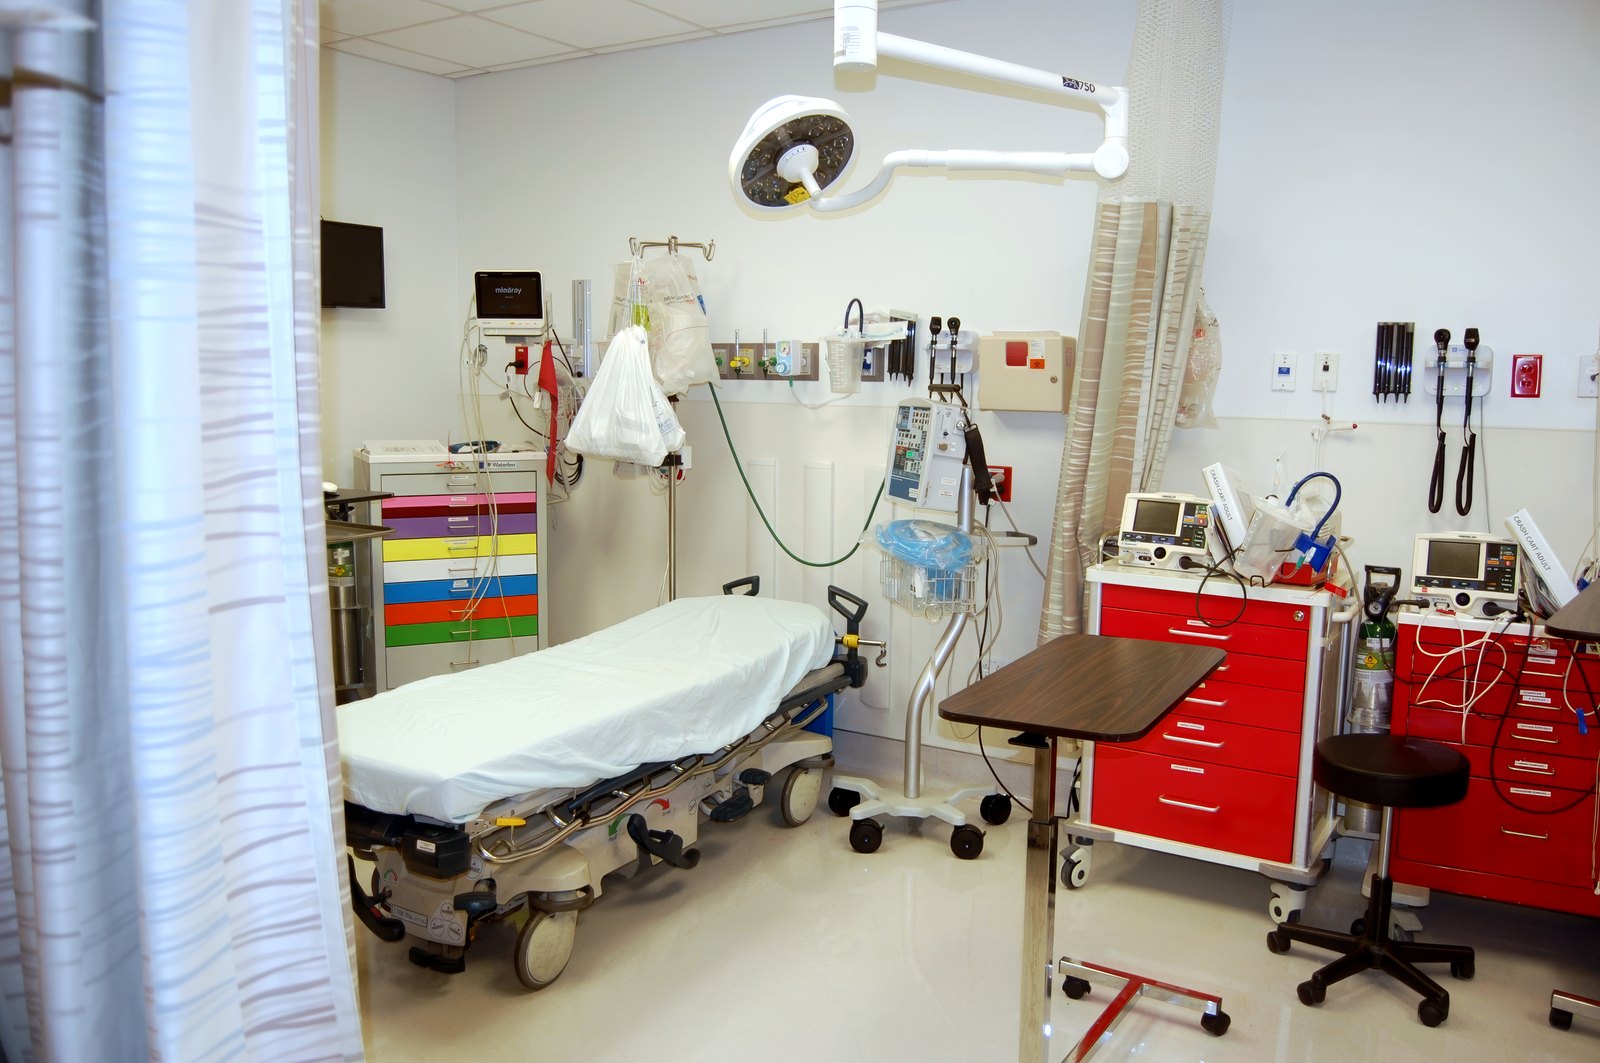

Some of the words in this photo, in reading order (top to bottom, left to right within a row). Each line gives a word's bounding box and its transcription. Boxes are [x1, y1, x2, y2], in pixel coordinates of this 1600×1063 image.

[1079, 81, 1095, 93] 750
[495, 287, 522, 295] mindray
[1209, 469, 1220, 488] CRASH
[1222, 503, 1233, 521] ADULT
[1513, 515, 1528, 536] CRASH
[1525, 535, 1538, 551] CART
[1535, 551, 1552, 571] ADULT
